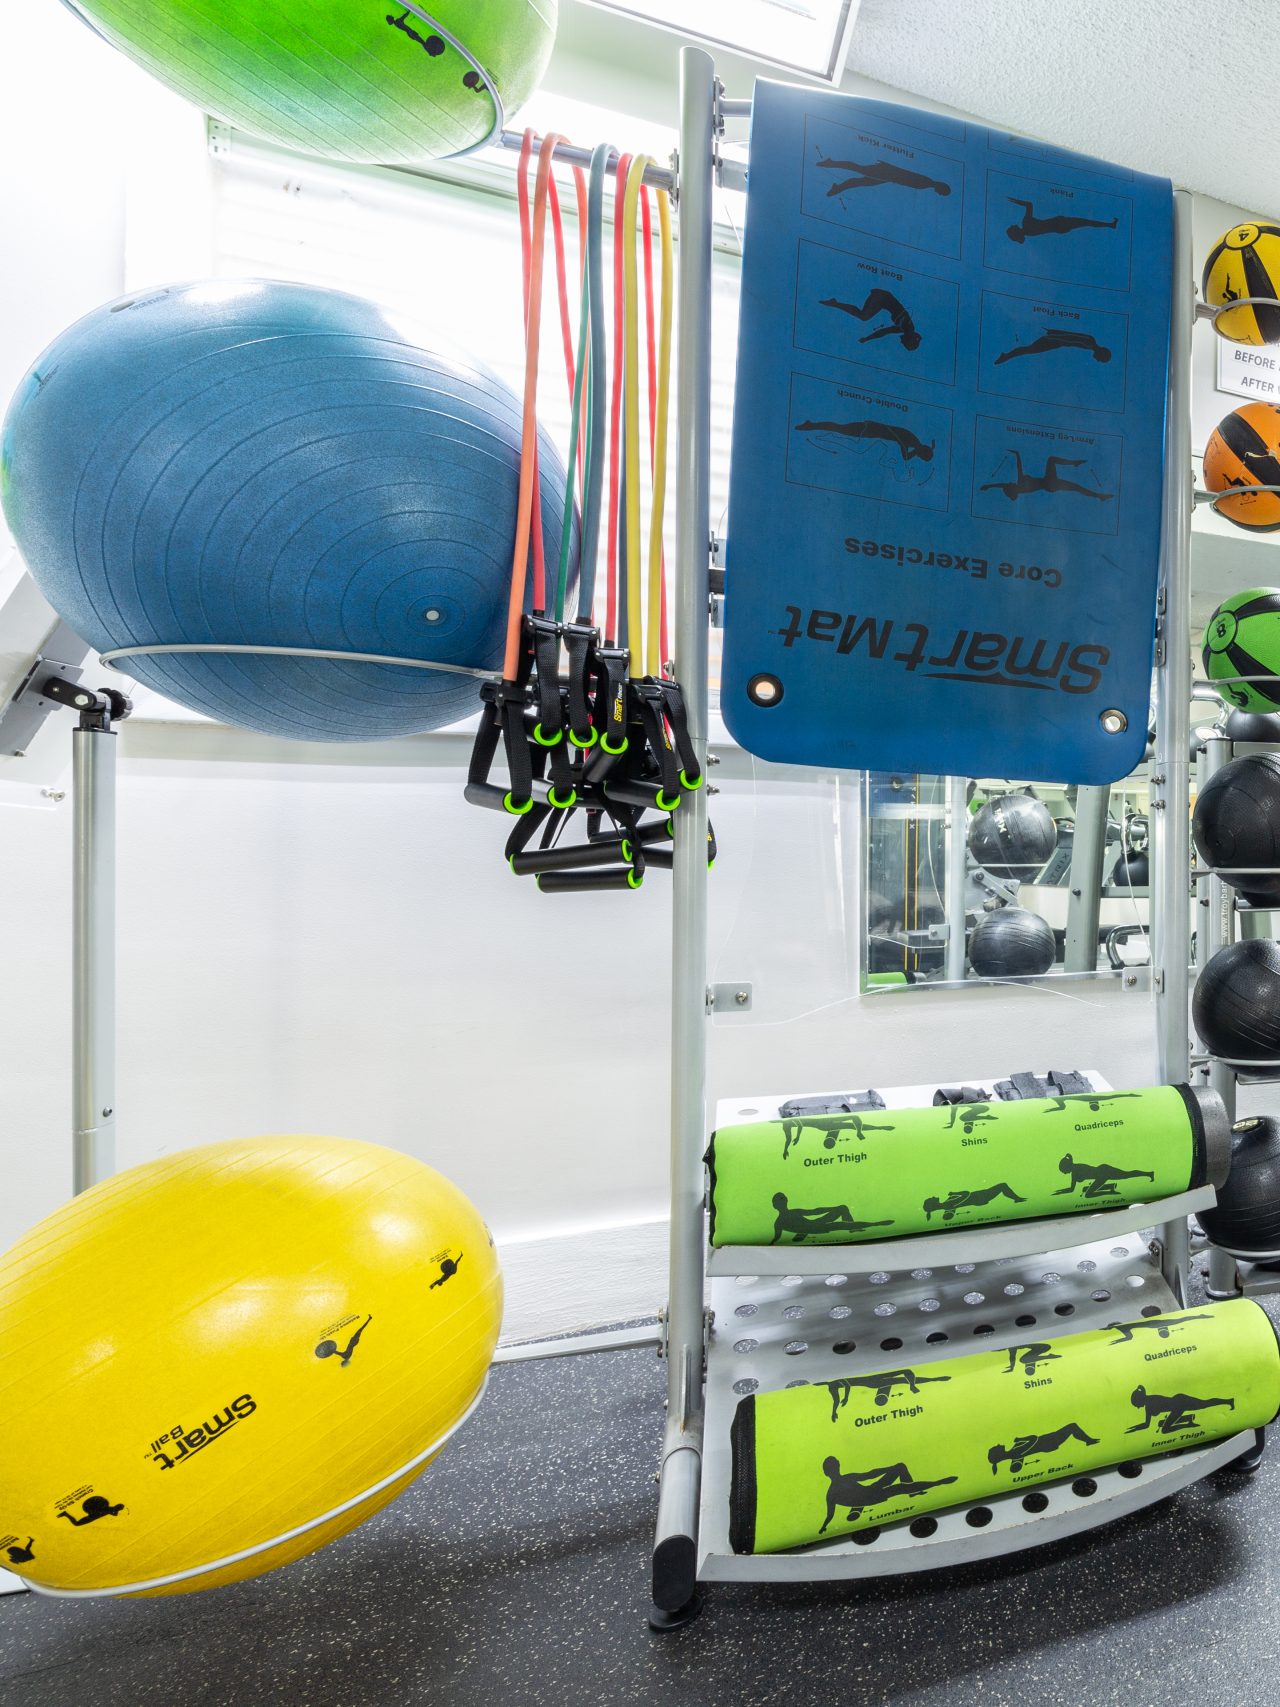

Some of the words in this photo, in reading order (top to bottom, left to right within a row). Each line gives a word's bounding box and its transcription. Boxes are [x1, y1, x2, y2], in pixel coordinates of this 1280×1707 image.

[1049, 187, 1074, 199] Plank
[856, 262, 878, 275] Row
[880, 266, 903, 282] Boat
[1033, 305, 1055, 317] Float
[1058, 308, 1080, 320] Back
[1234, 349, 1276, 371] BEFORE
[1241, 376, 1275, 394] AFTER
[837, 389, 873, 405] Crunch
[873, 397, 909, 413] Double
[1005, 424, 1056, 440] Extensions
[844, 536, 988, 580] Exercises
[998, 561, 1063, 589] Core
[1073, 1118, 1125, 1132] Quadriceps
[960, 1135, 988, 1148] Shins
[803, 1155, 835, 1168] Outer
[837, 1151, 868, 1165] Thigh
[1143, 1343, 1198, 1363] Quadriceps
[1023, 1375, 1053, 1391] Shins
[854, 1412, 888, 1429] Outer
[890, 1404, 924, 1421] Thigh
[150, 1424, 185, 1454] Ball
[152, 1393, 257, 1471] Smart
[1151, 1437, 1177, 1449] Inner
[1179, 1429, 1206, 1442] Thigh
[1012, 1470, 1044, 1484] Upper
[1046, 1462, 1074, 1475] Back
[868, 1504, 916, 1522] Lumbar
